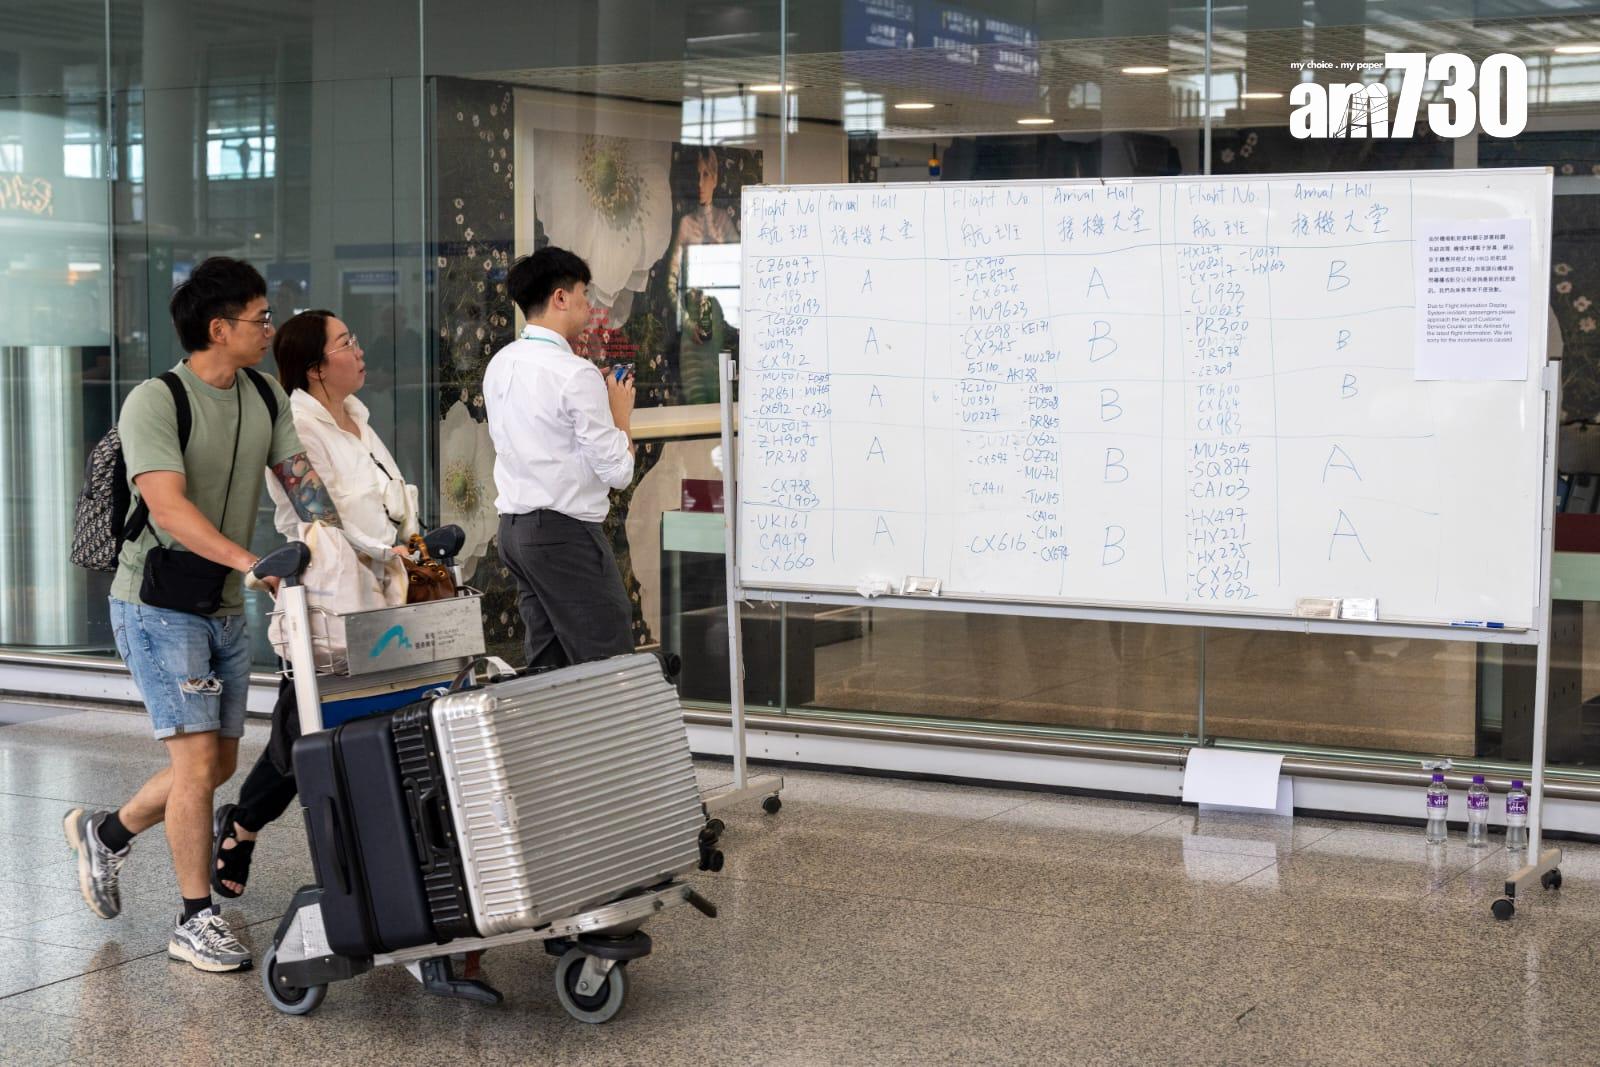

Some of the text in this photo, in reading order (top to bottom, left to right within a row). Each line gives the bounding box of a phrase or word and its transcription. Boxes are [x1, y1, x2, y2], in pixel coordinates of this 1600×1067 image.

[872, 194, 897, 209] Hall
[952, 190, 995, 216] Flight
[1054, 186, 1134, 204] Arrival Hall
[1189, 183, 1225, 206] Flight
[1294, 182, 1372, 201] Arrival Hall
[753, 198, 787, 222] Flight
[861, 268, 874, 294] A
[1086, 266, 1111, 300] A
[1326, 260, 1351, 292] B
[864, 326, 880, 355] A
[1088, 320, 1118, 363] B
[1335, 329, 1352, 351] B
[869, 384, 883, 407] A
[1342, 373, 1359, 400] B
[1100, 388, 1123, 422] B
[865, 436, 886, 463] A
[1104, 447, 1129, 484] B
[1322, 444, 1363, 484] A
[873, 514, 895, 546] A
[1328, 508, 1372, 563] A
[1102, 525, 1126, 567] B
